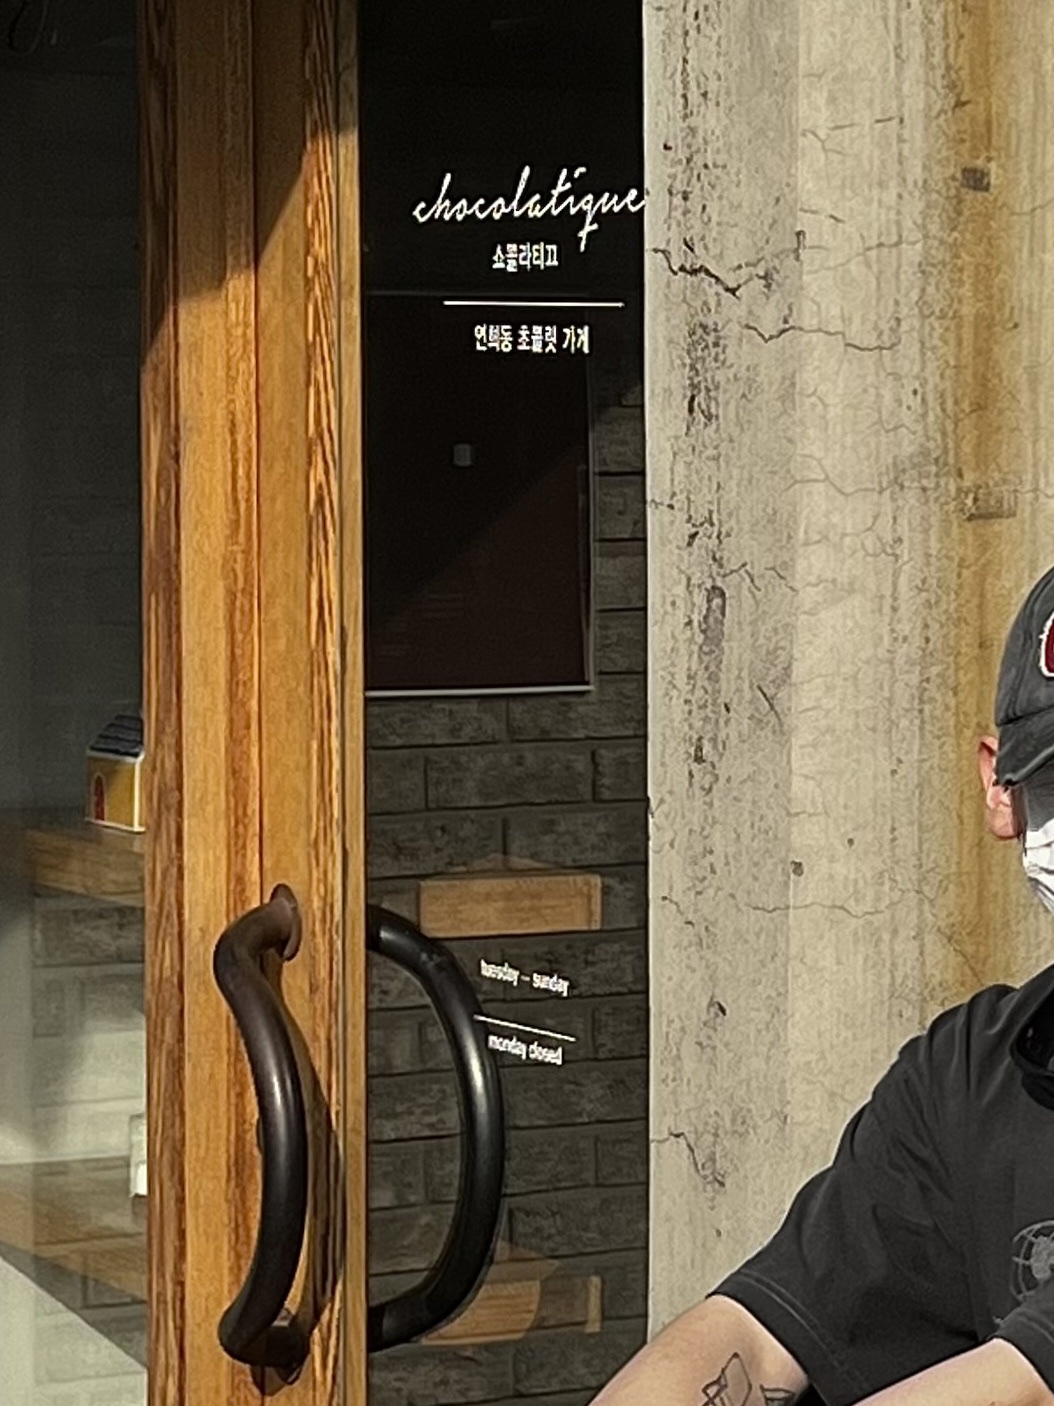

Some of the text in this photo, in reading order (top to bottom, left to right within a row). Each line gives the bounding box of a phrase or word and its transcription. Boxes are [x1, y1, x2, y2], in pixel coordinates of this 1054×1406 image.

[412, 165, 645, 252] chocolatique
[474, 323, 590, 354] 연희동 초콜릿 가게
